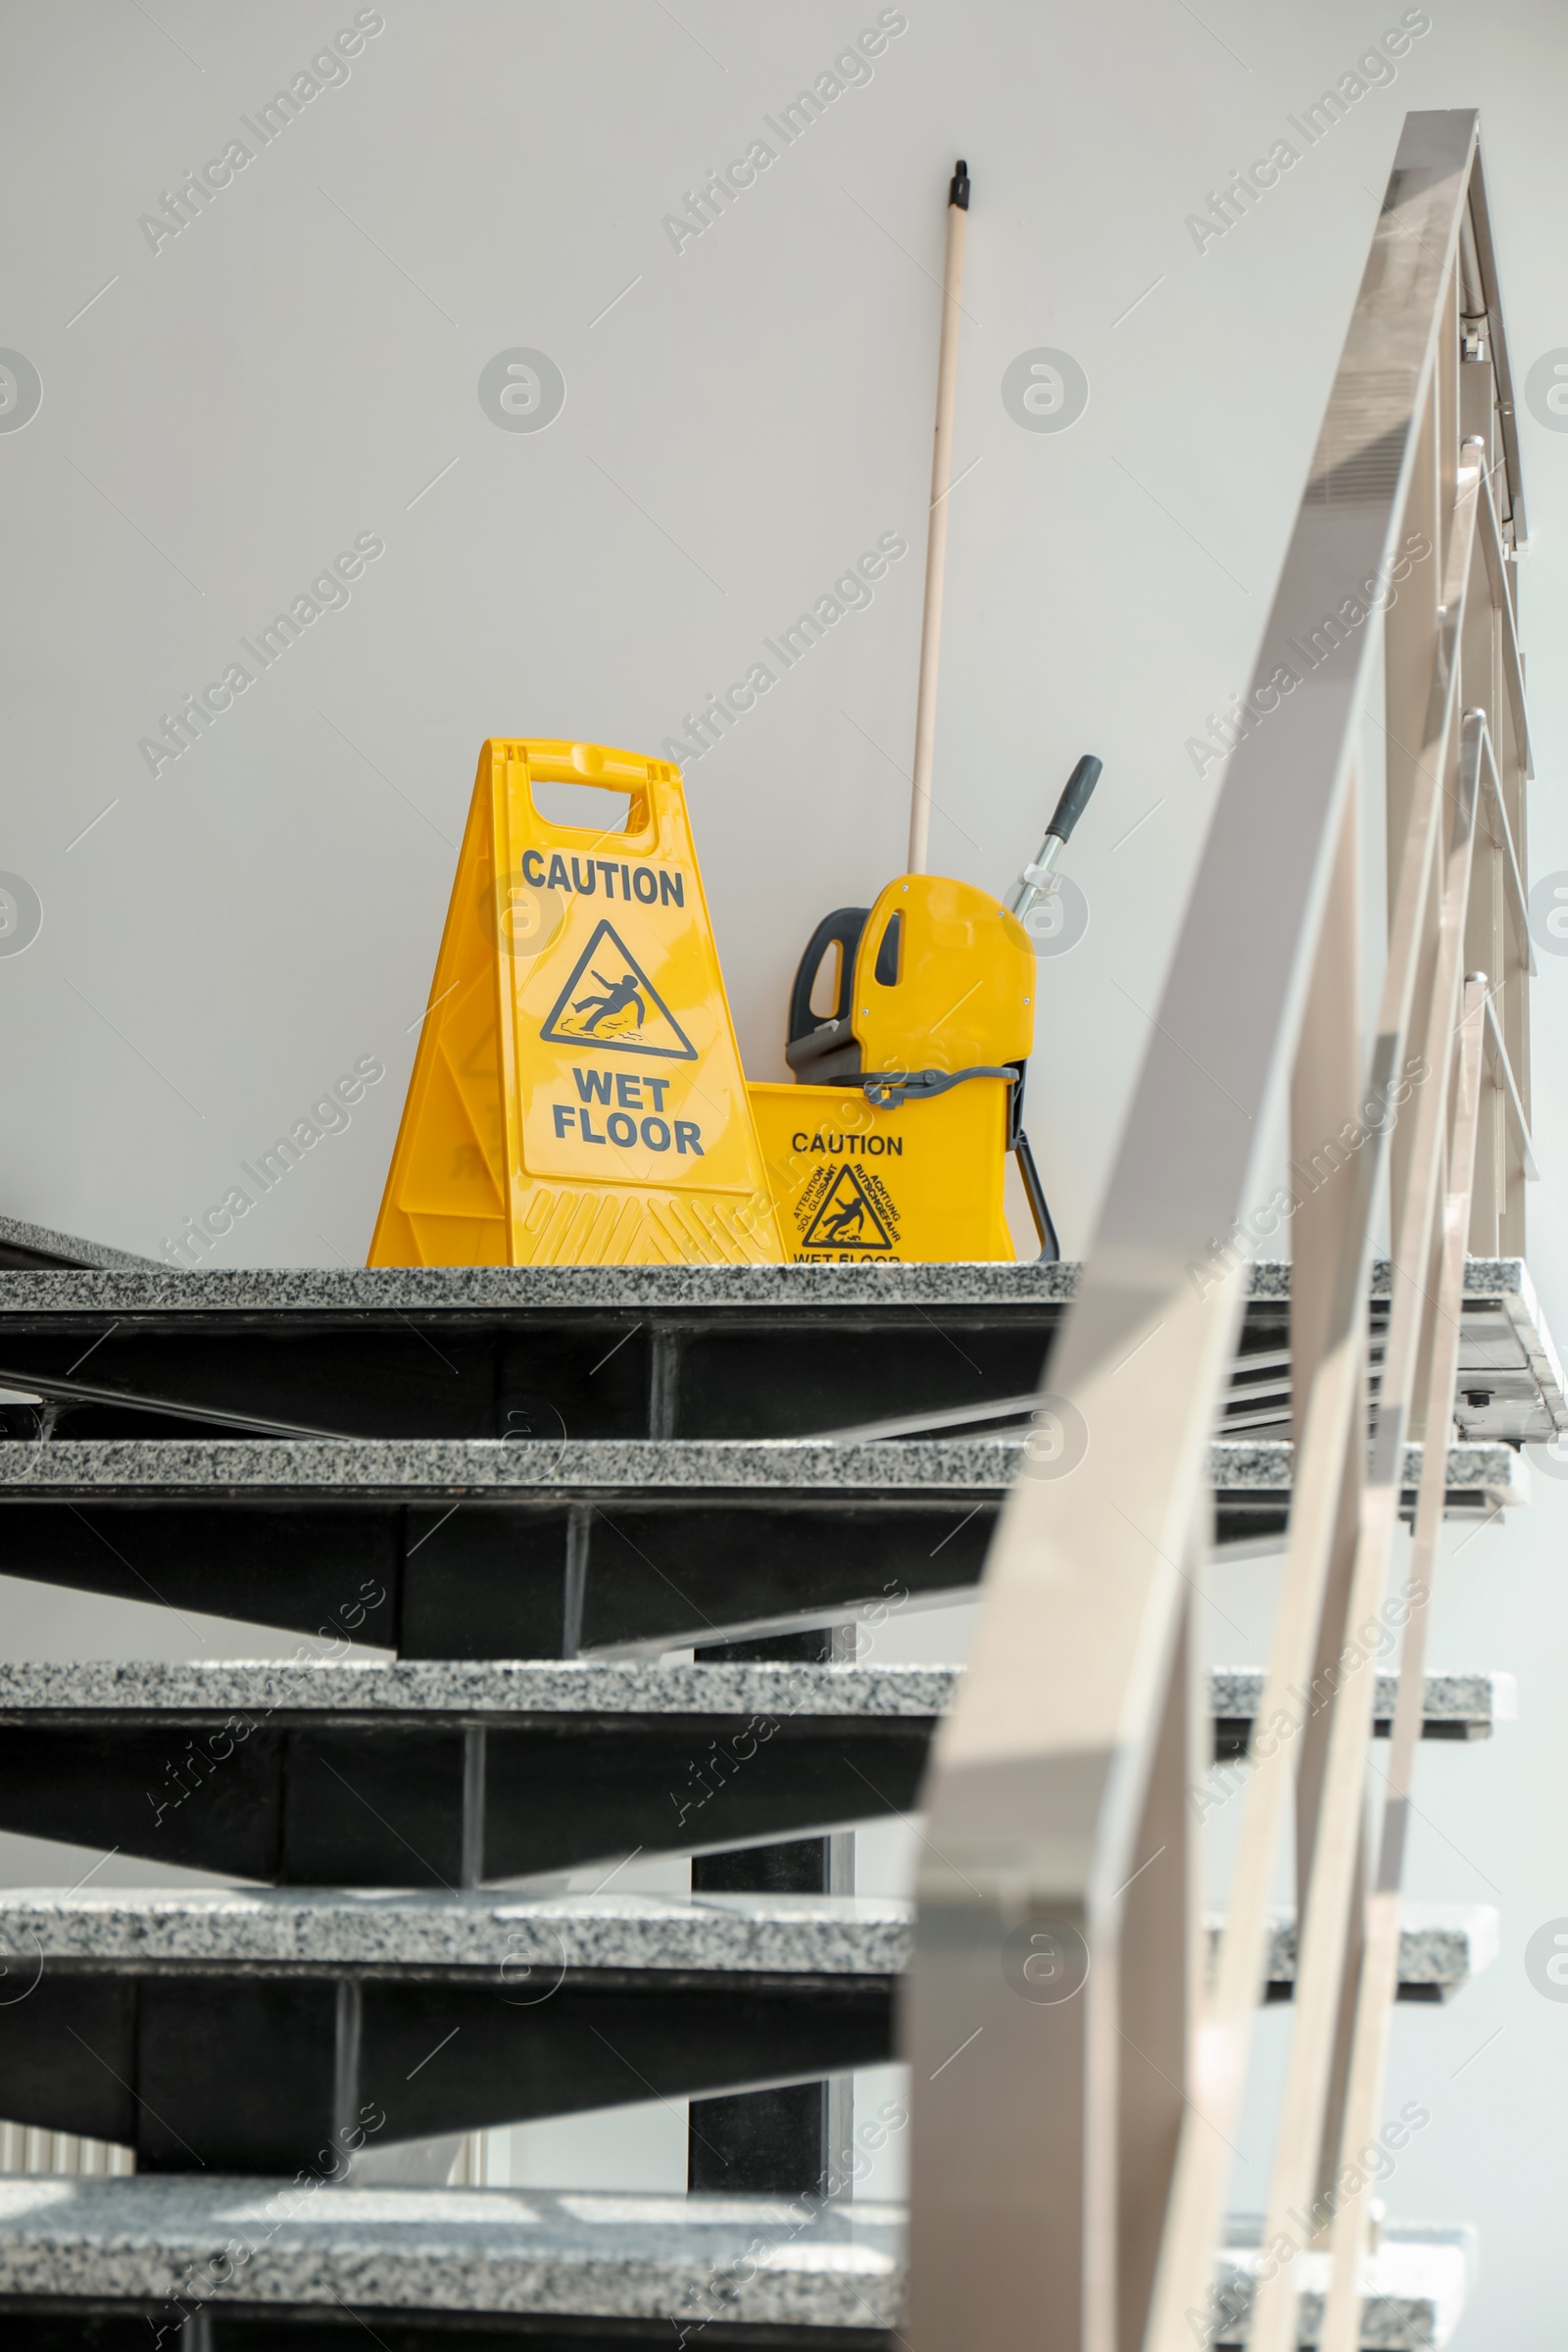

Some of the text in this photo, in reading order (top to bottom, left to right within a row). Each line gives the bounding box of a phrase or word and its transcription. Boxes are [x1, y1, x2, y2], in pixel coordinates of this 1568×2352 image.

[521, 850, 684, 907] CAUTION
[572, 1067, 669, 1112] WET
[552, 1103, 705, 1155] FLOOR
[792, 1133, 903, 1155] CAUTION
[793, 1166, 825, 1219] ATTENTION
[797, 1163, 838, 1233] SOL GLISSANT
[854, 1163, 901, 1243] RUTSCHGEFAHR
[870, 1175, 901, 1222] ACHTUNG
